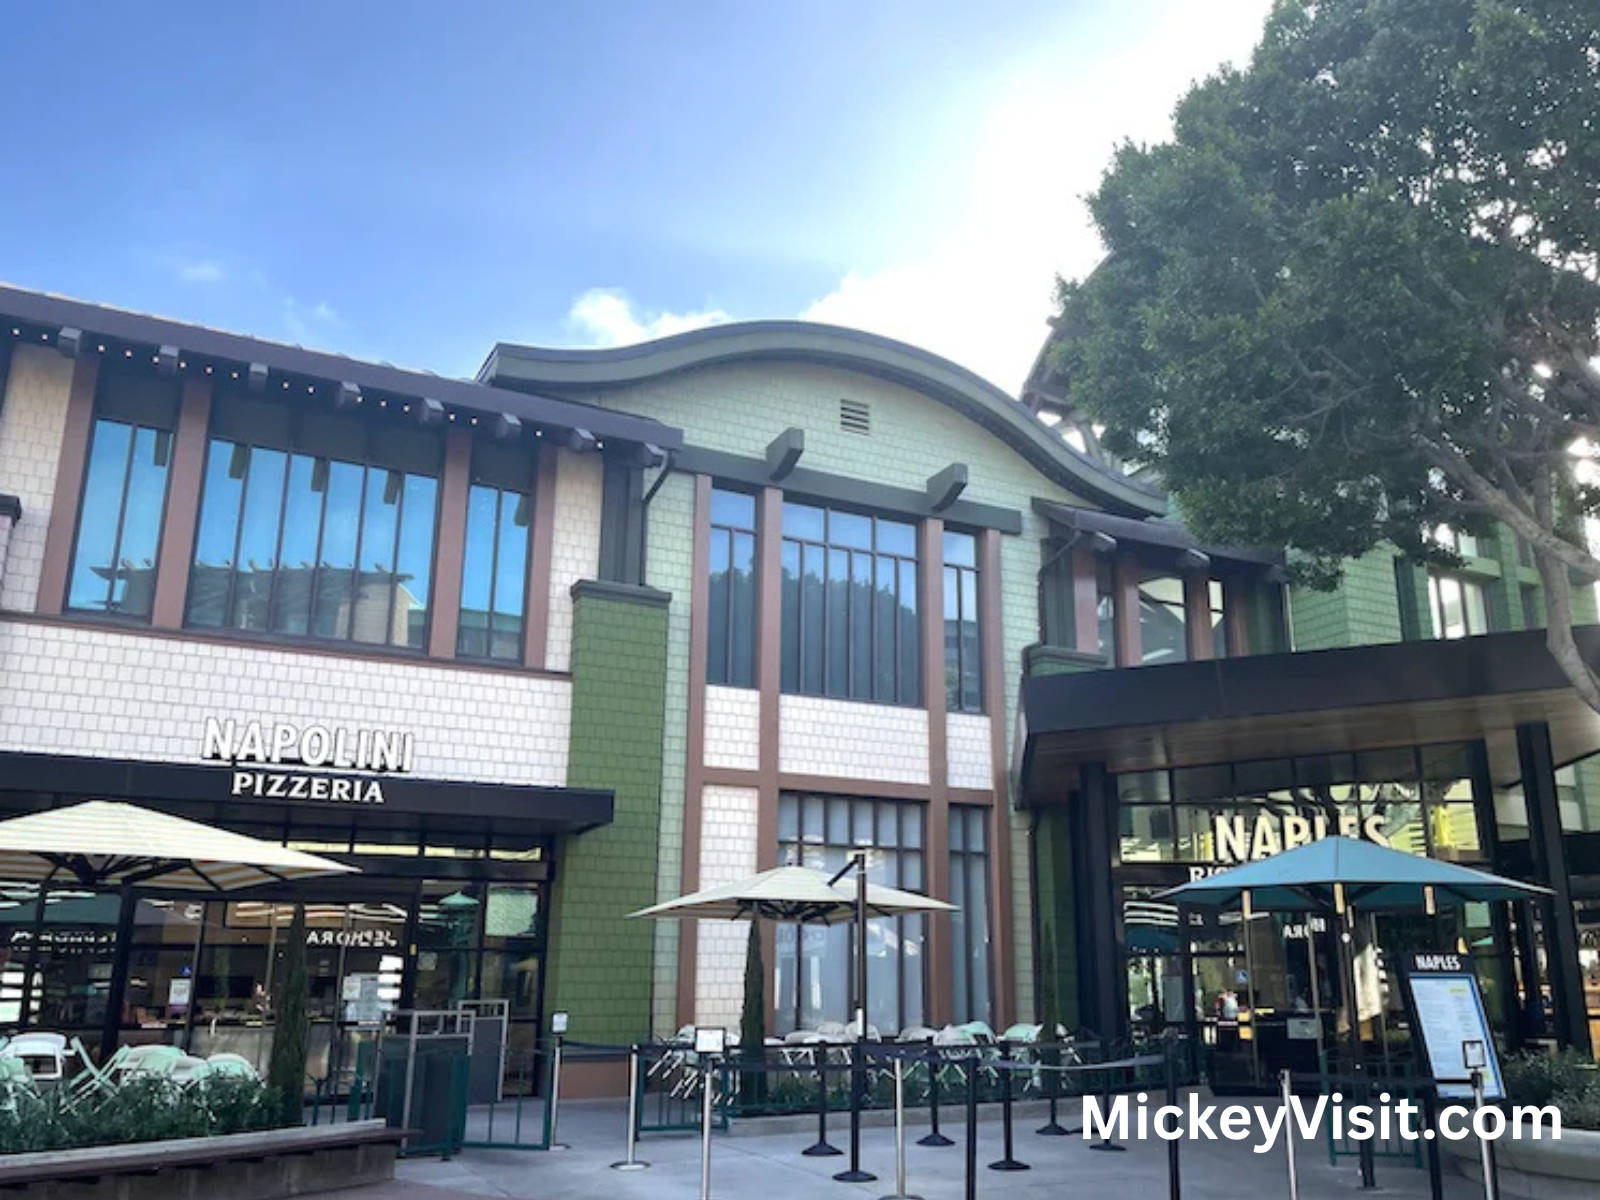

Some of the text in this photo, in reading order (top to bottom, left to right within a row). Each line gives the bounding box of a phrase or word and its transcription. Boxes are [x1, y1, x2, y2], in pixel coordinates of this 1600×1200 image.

[202, 717, 414, 773] NAPOLINI
[231, 772, 384, 803] PIZZERIA
[1415, 954, 1461, 970] NAPLES
